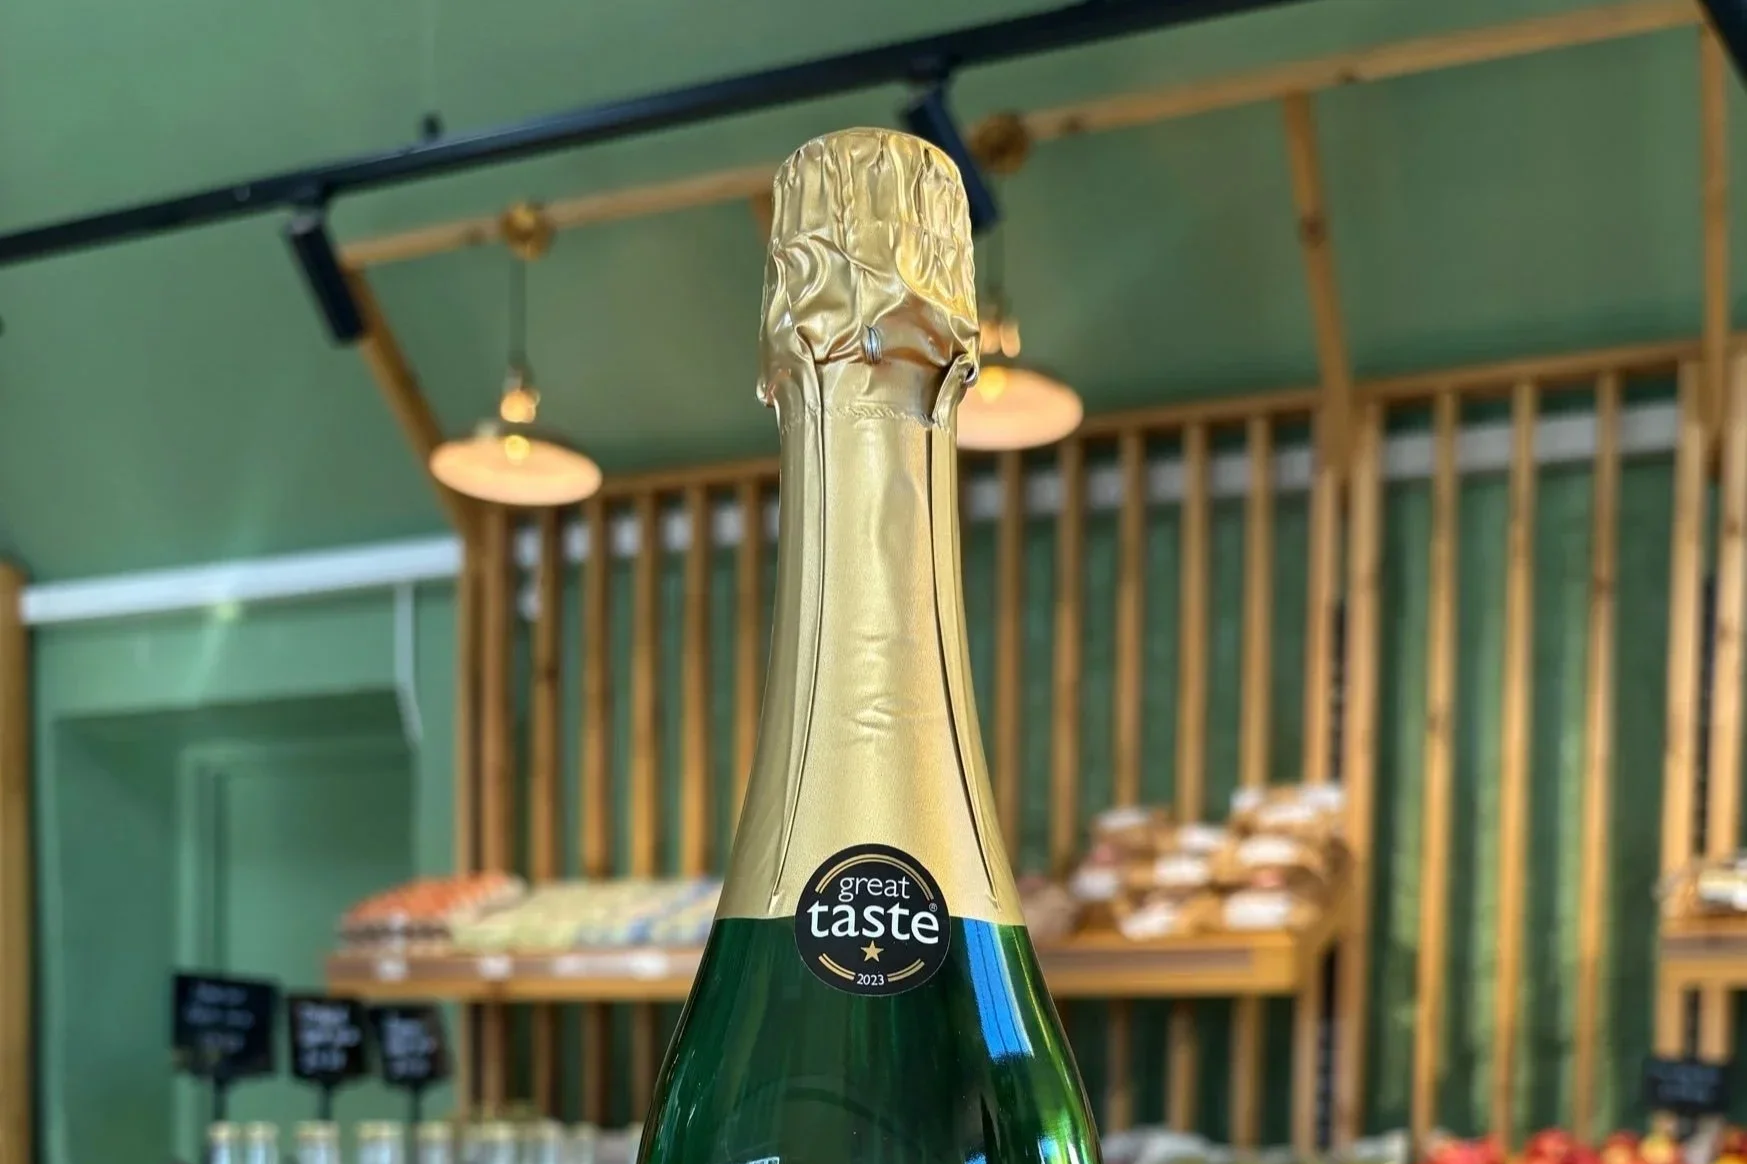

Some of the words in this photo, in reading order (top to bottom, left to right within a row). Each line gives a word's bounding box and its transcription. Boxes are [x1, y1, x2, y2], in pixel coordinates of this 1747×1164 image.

[838, 876, 910, 902] great
[806, 900, 940, 945] taste
[856, 973, 885, 986] 2023
